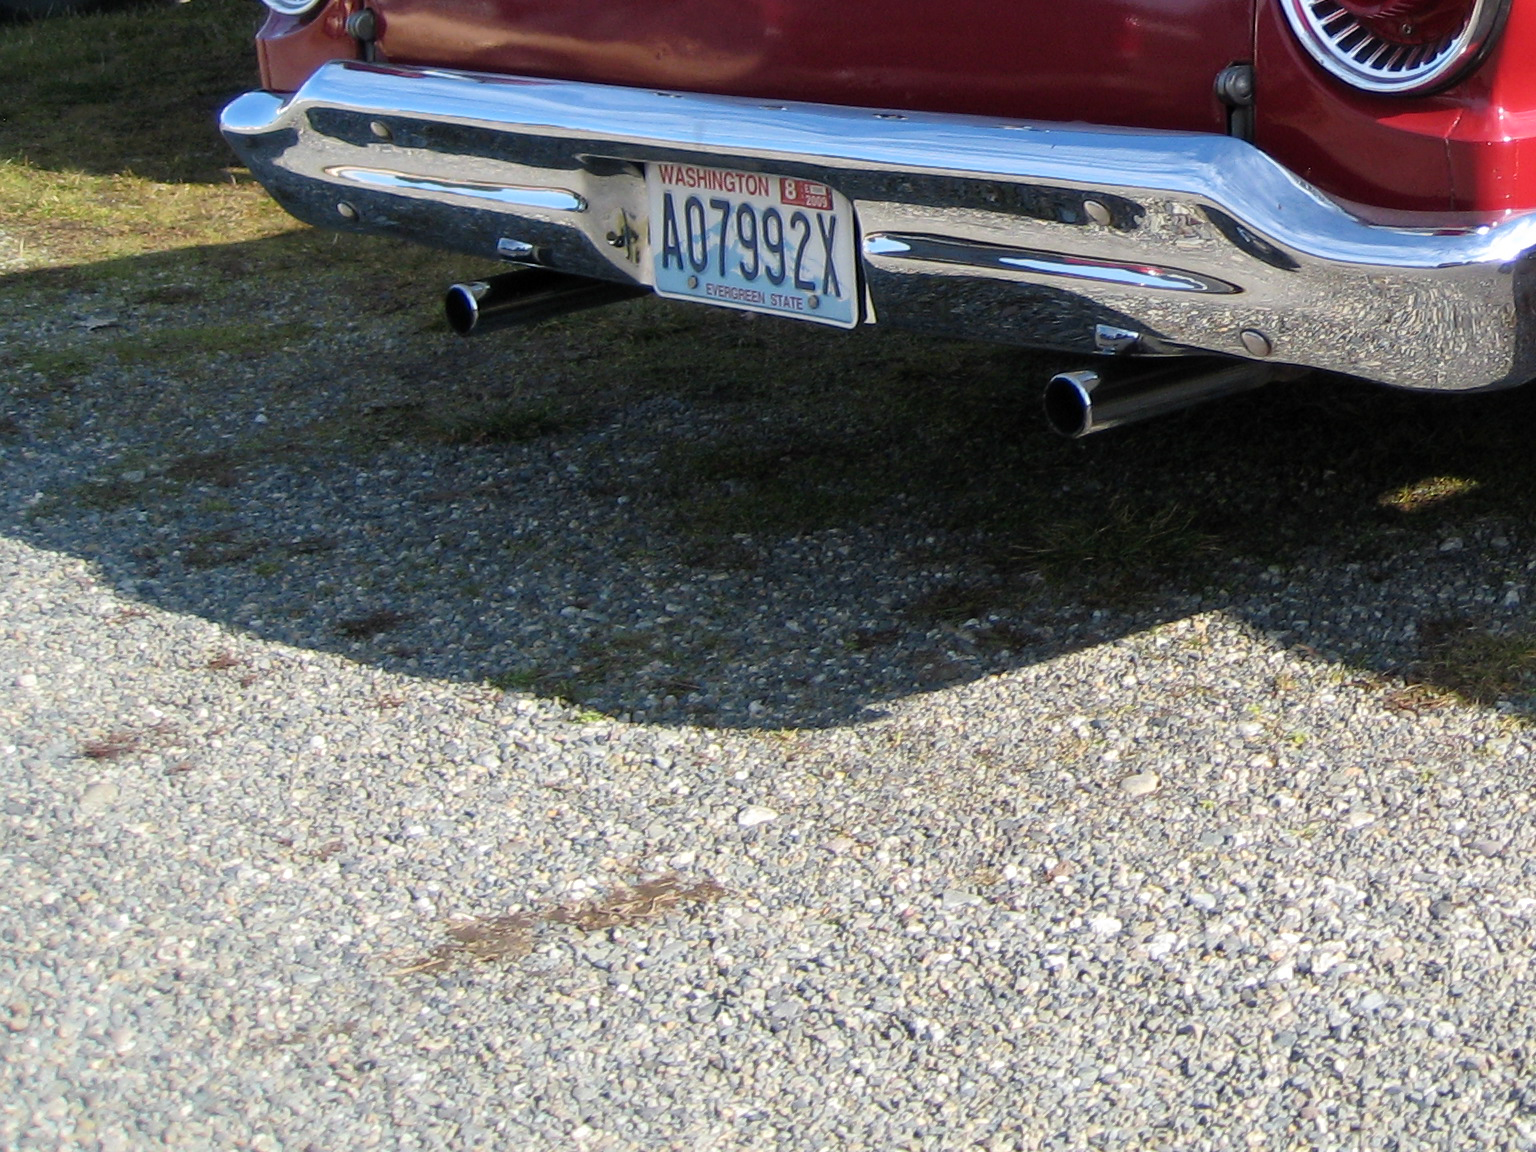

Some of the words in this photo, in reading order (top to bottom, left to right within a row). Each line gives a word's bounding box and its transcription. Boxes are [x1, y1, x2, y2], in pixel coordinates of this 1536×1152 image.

[658, 164, 770, 197] WASHINGTON
[784, 179, 797, 200] 8
[661, 192, 841, 298] A07992X
[705, 282, 766, 305] EVERGREEN
[770, 292, 804, 311] STATE
